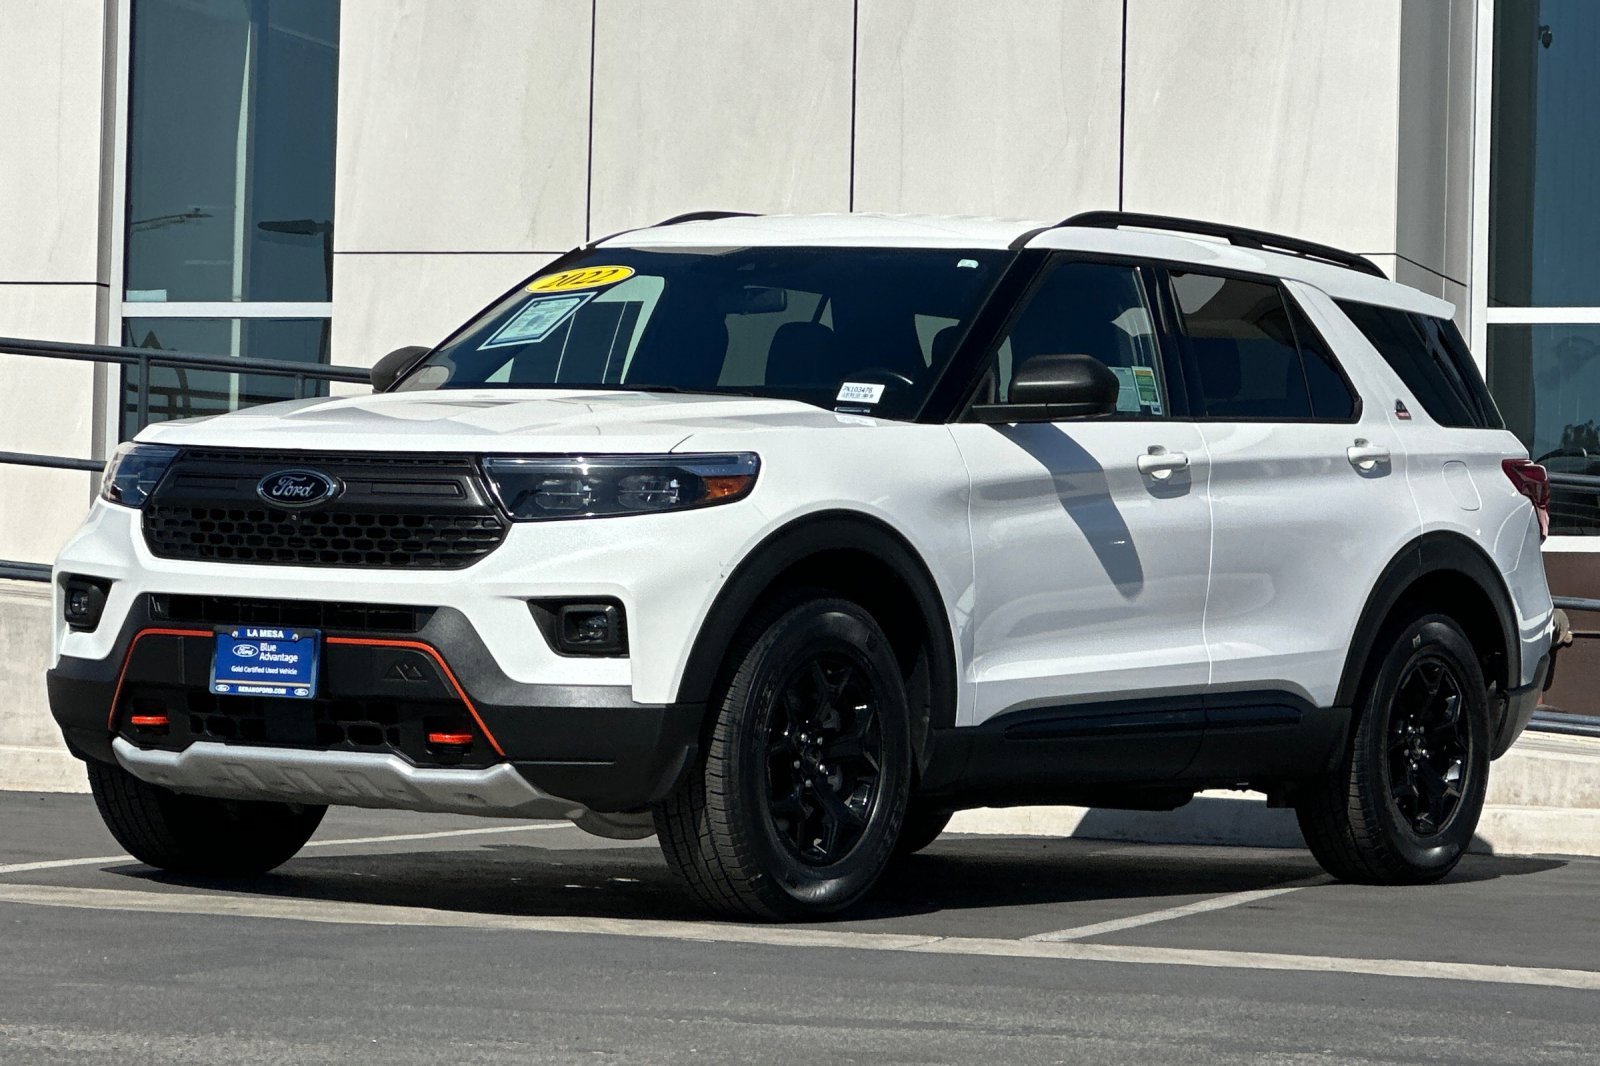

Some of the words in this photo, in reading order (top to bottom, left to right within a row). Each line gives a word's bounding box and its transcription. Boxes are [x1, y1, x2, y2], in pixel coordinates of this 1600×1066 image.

[537, 269, 620, 290] 2022
[272, 475, 316, 497] Ford
[246, 629, 259, 638] LA
[259, 629, 284, 639] MESA
[260, 642, 277, 652] Blue
[259, 652, 299, 664] Advantage
[231, 665, 244, 673] Gold
[244, 666, 265, 674] Certified
[265, 667, 279, 675] Used
